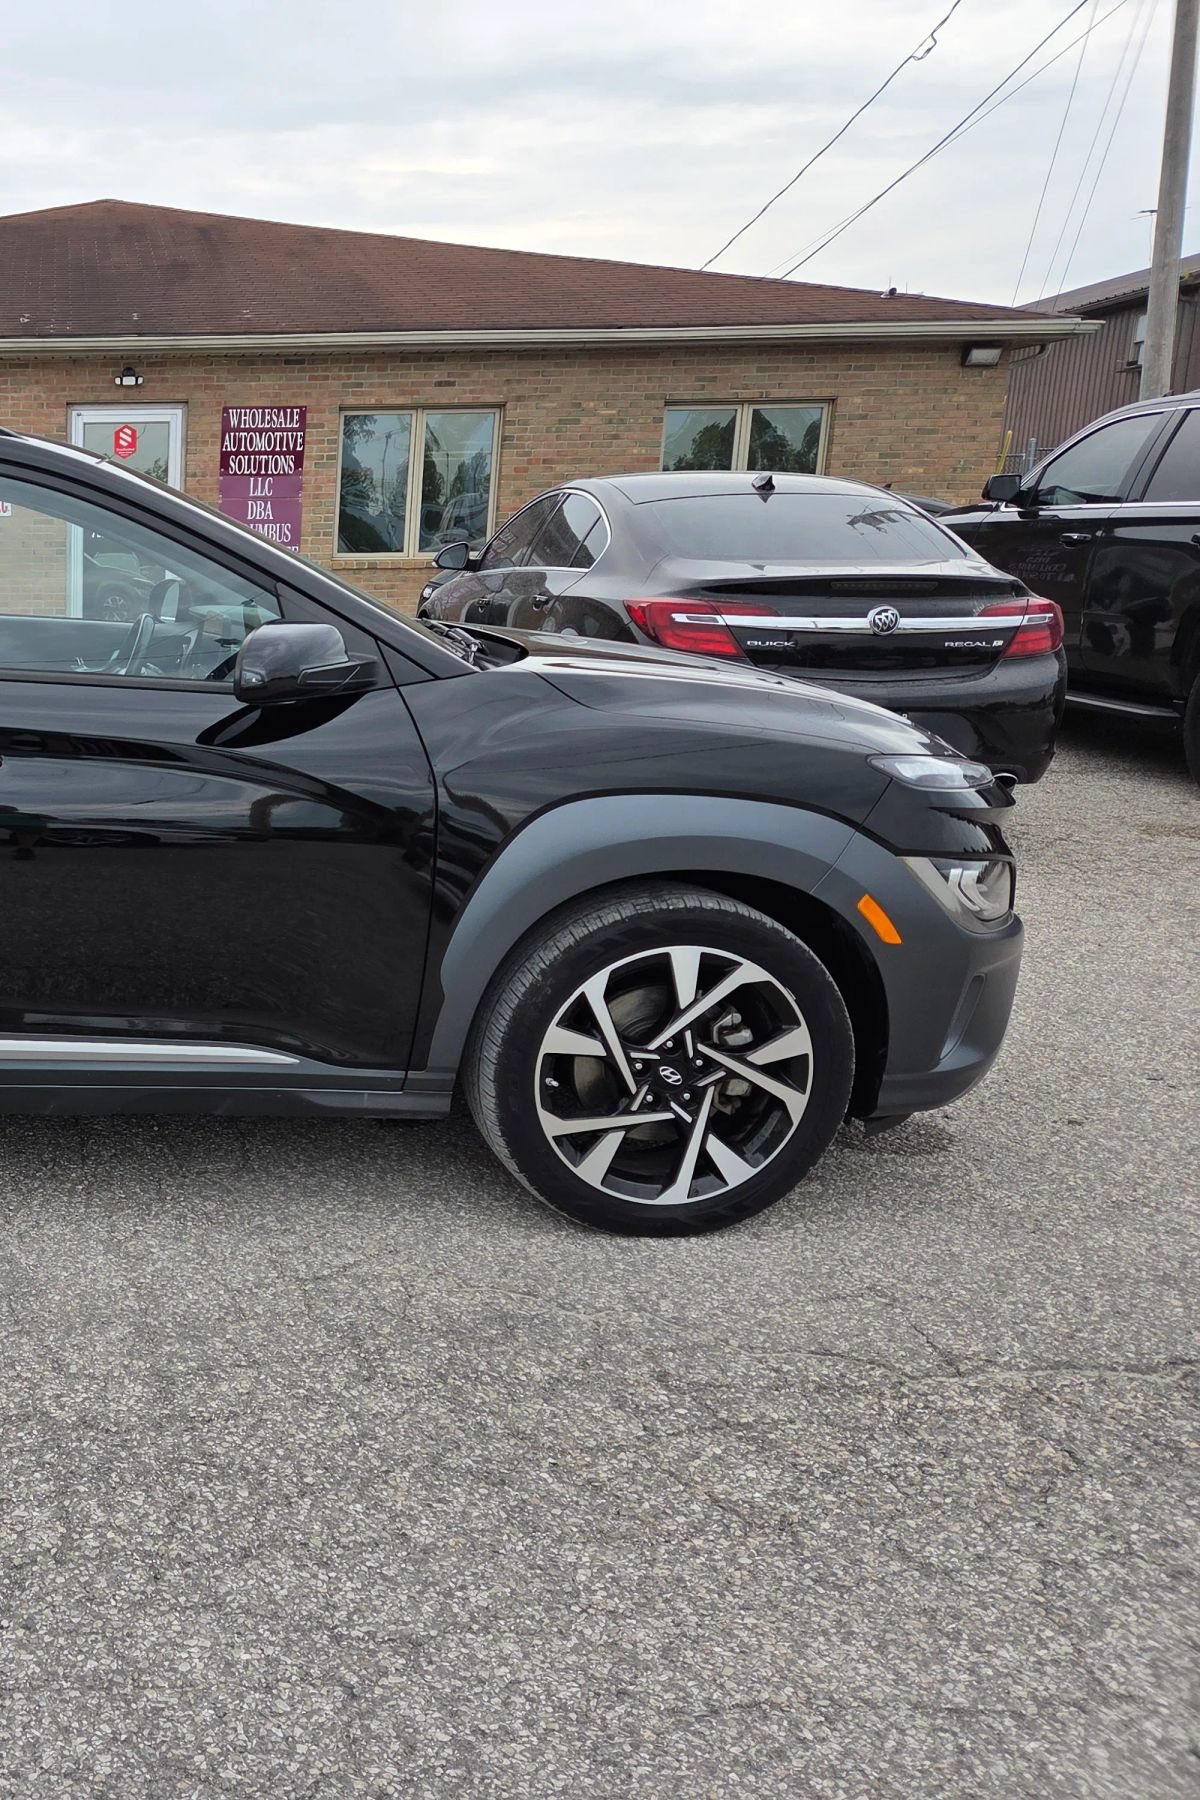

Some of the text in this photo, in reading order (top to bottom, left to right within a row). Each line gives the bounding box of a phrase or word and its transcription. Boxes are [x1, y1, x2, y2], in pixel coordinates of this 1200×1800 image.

[228, 408, 300, 429] WHOLESALE
[222, 432, 304, 451] AUTOMOTIVE
[228, 455, 295, 475] SOLUTIONS
[249, 477, 273, 497] LLC
[247, 500, 274, 520] DBA
